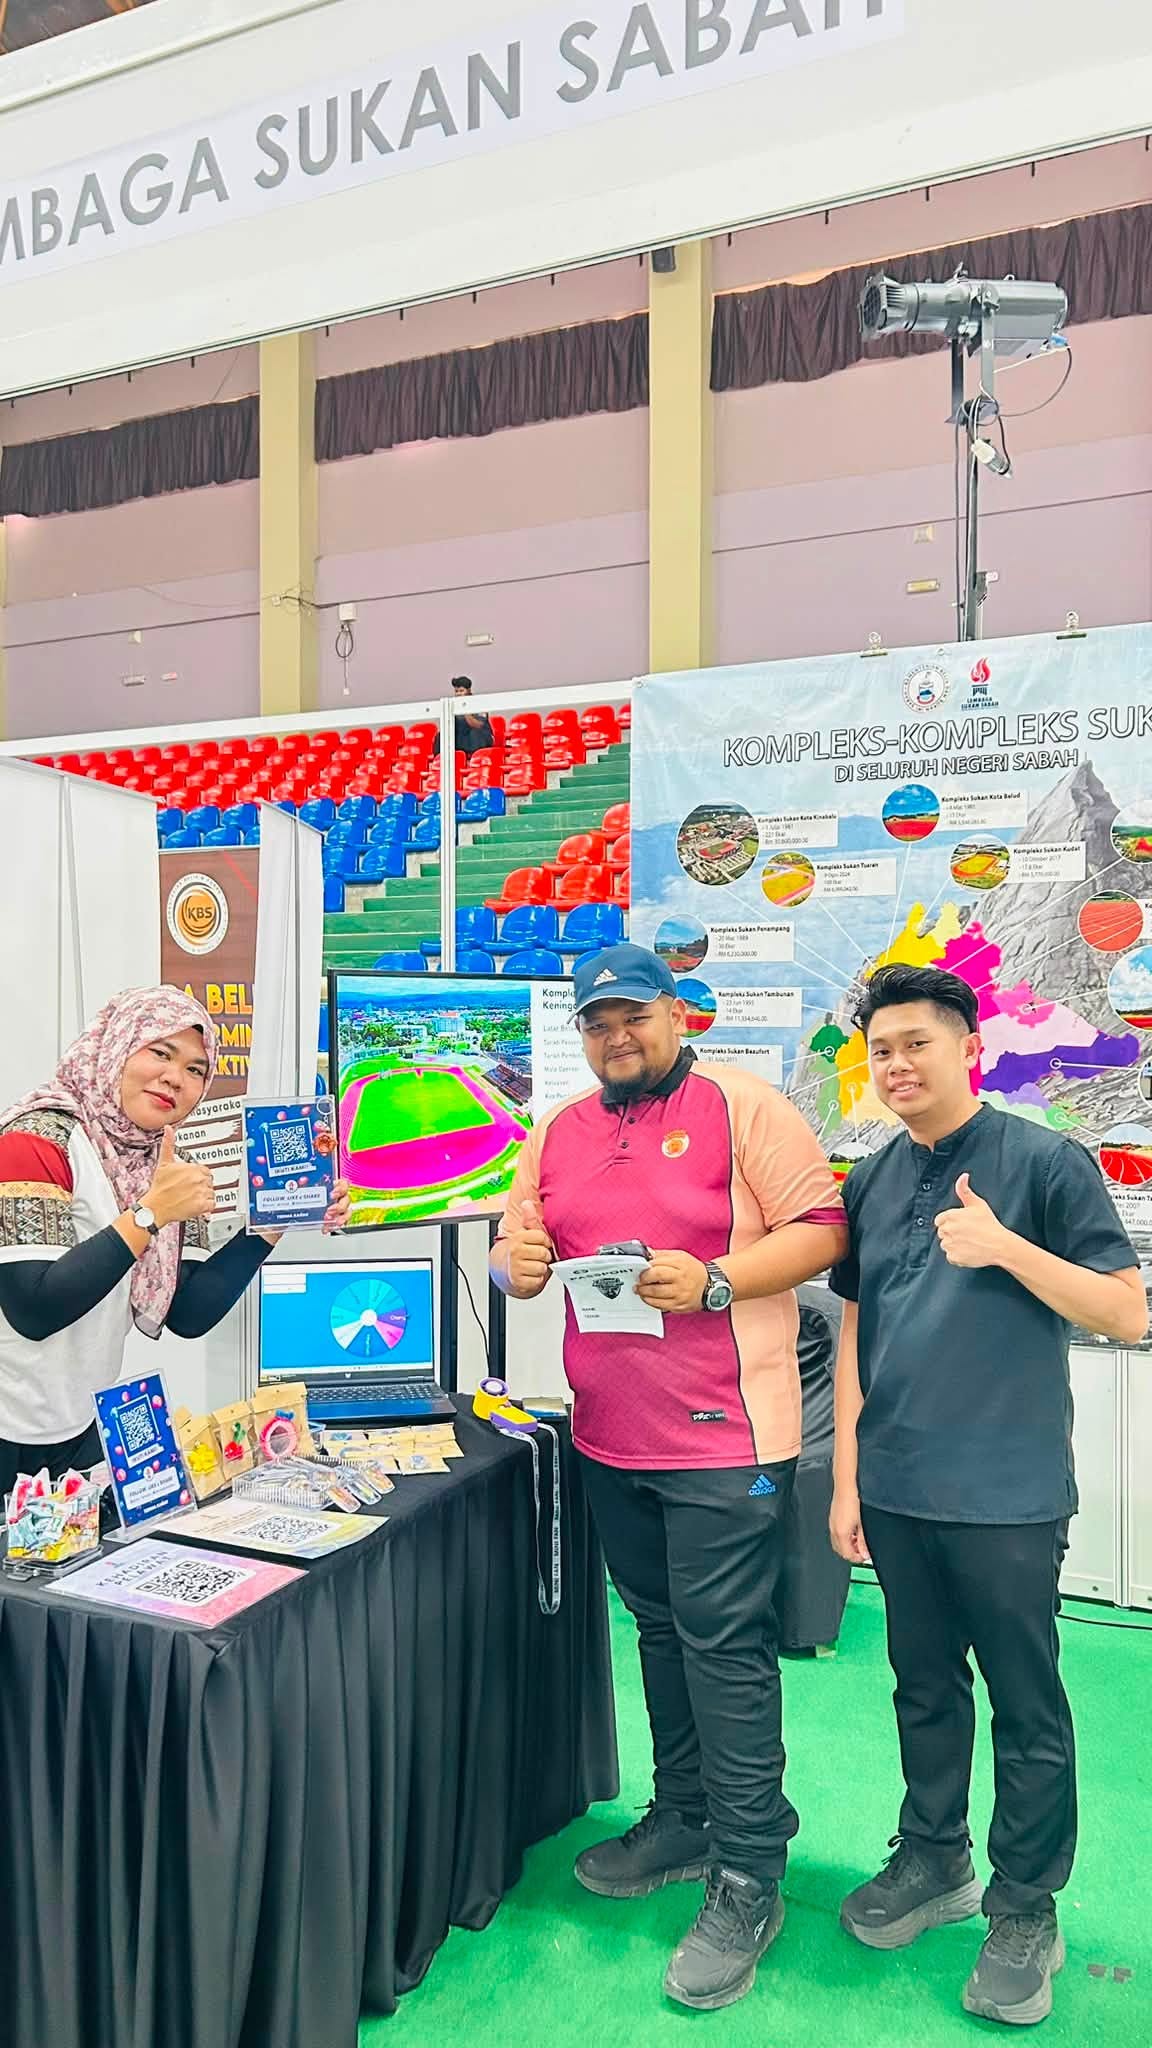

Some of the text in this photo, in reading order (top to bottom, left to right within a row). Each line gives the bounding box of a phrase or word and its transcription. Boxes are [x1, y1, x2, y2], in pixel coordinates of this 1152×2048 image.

[254, 40, 520, 189] SUKAN
[723, 710, 1079, 767] KOMPLEKS-KOMPLEKS
[835, 748, 1079, 782] DI SELURUH NEGERI SABAH
[188, 906, 213, 922] KBS
[206, 984, 254, 1014] BEL
[176, 1130, 206, 1140] kanan
